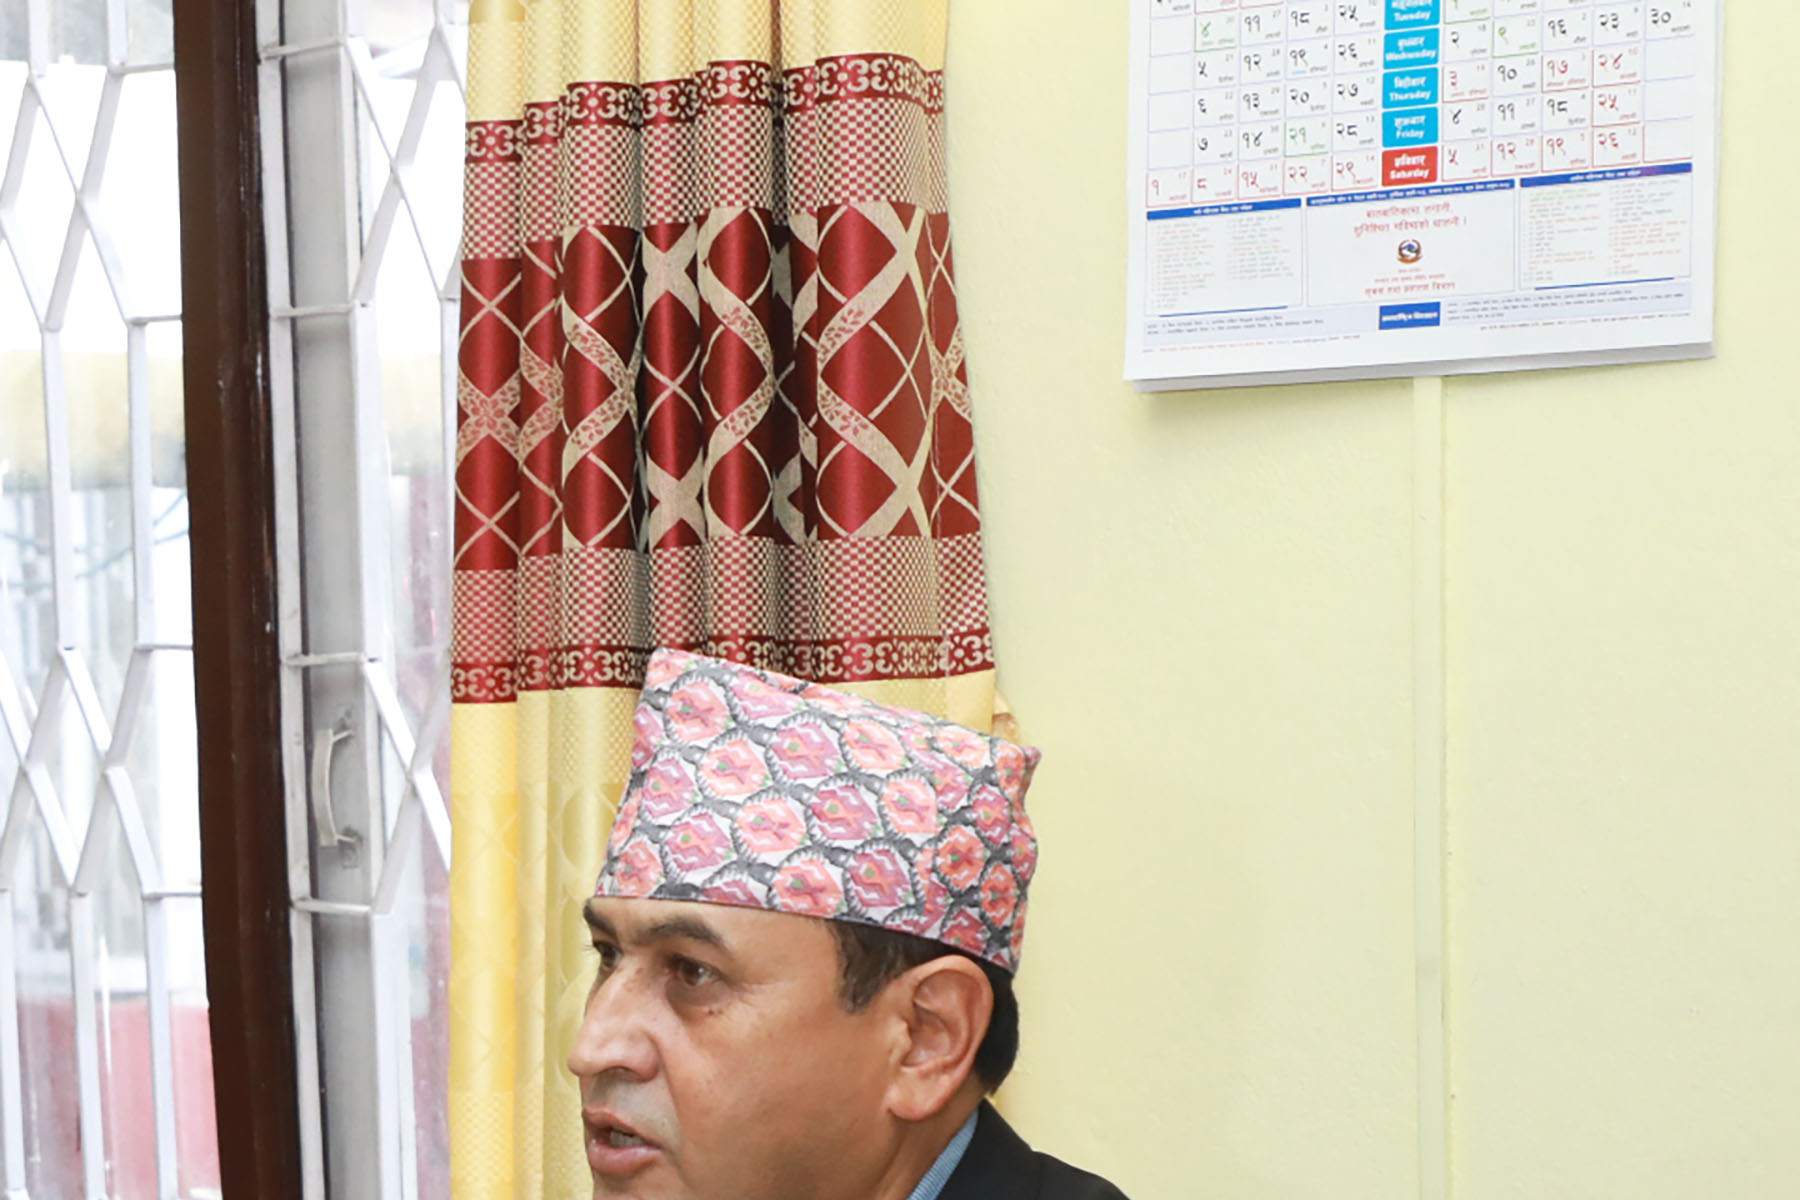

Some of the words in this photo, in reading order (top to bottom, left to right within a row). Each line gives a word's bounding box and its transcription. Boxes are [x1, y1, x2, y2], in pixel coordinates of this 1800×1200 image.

[1200, 22, 1212, 39] ४
[1244, 15, 1261, 33] ११
[1291, 11, 1311, 28] १८
[1339, 5, 1359, 22] २५
[1394, 11, 1430, 21] Tuesday
[1451, 31, 1460, 45] २
[1497, 26, 1509, 45] ९
[1548, 19, 1567, 38] १६
[1599, 13, 1620, 30] २३
[1651, 8, 1673, 26] ३०
[1198, 62, 1209, 78] ५
[1244, 54, 1262, 72] १२
[1290, 49, 1309, 67] १९
[1338, 43, 1358, 60] २६
[1386, 50, 1436, 61] Wednesday
[1449, 71, 1458, 89] ३
[1497, 65, 1518, 83] १०
[1547, 60, 1569, 78] १७
[1598, 53, 1624, 73] २४
[1198, 99, 1208, 114] ६
[1243, 93, 1261, 110] १३
[1290, 89, 1310, 104] २०
[1337, 84, 1359, 98] २७
[1389, 91, 1431, 101] Thursday
[1451, 109, 1462, 125] ४
[1497, 103, 1515, 122] ११
[1547, 99, 1569, 116] १८
[1598, 94, 1620, 112] २५
[1198, 138, 1209, 152] ७
[1242, 132, 1264, 149] १४
[1289, 127, 1307, 145] २१
[1336, 123, 1358, 137] २८
[1396, 129, 1424, 139] Friday
[1448, 149, 1459, 166] ५
[1497, 142, 1517, 161] १२
[1546, 138, 1567, 156] १९
[1598, 132, 1619, 149] २६
[1151, 179, 1160, 197] १
[1197, 178, 1208, 190] ८
[1241, 172, 1260, 189] १५
[1289, 166, 1308, 182] २२
[1336, 162, 1358, 185] २९
[1390, 170, 1429, 179] Saturday
